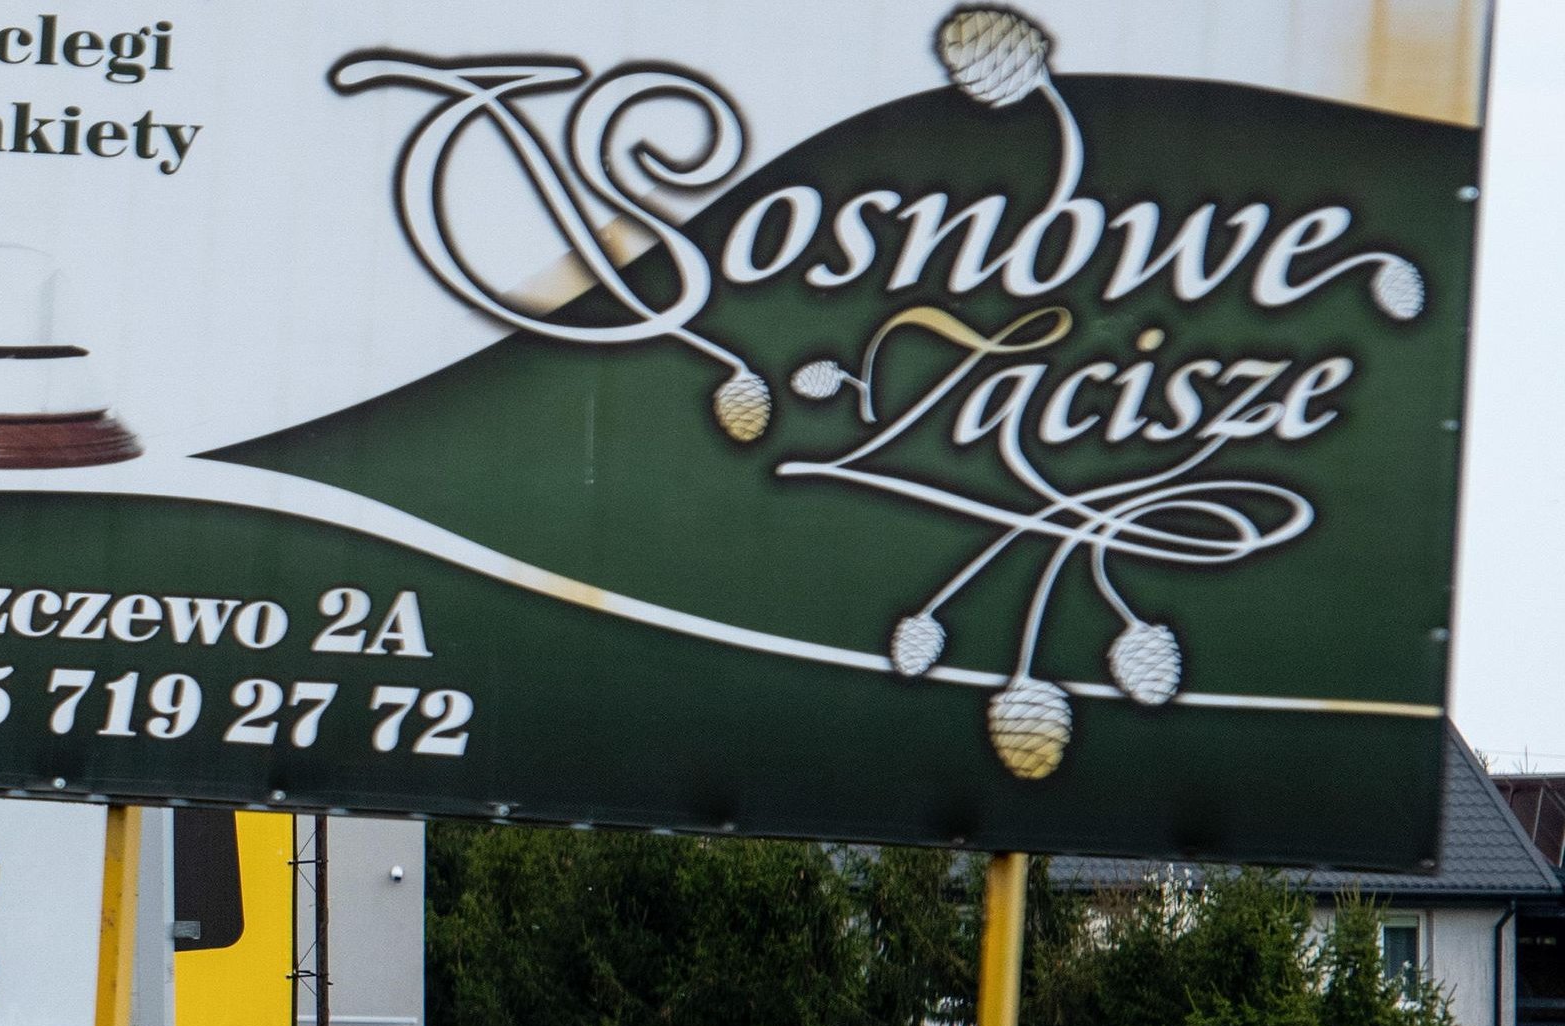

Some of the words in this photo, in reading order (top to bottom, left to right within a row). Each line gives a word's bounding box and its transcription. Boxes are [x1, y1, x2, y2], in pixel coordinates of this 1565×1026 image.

[331, 50, 1374, 344] Sosnowe
[778, 305, 1357, 520] Zacisze
[312, 587, 432, 657] 2A
[48, 668, 202, 739] 719
[224, 678, 338, 748] 27
[371, 685, 473, 756] 72
